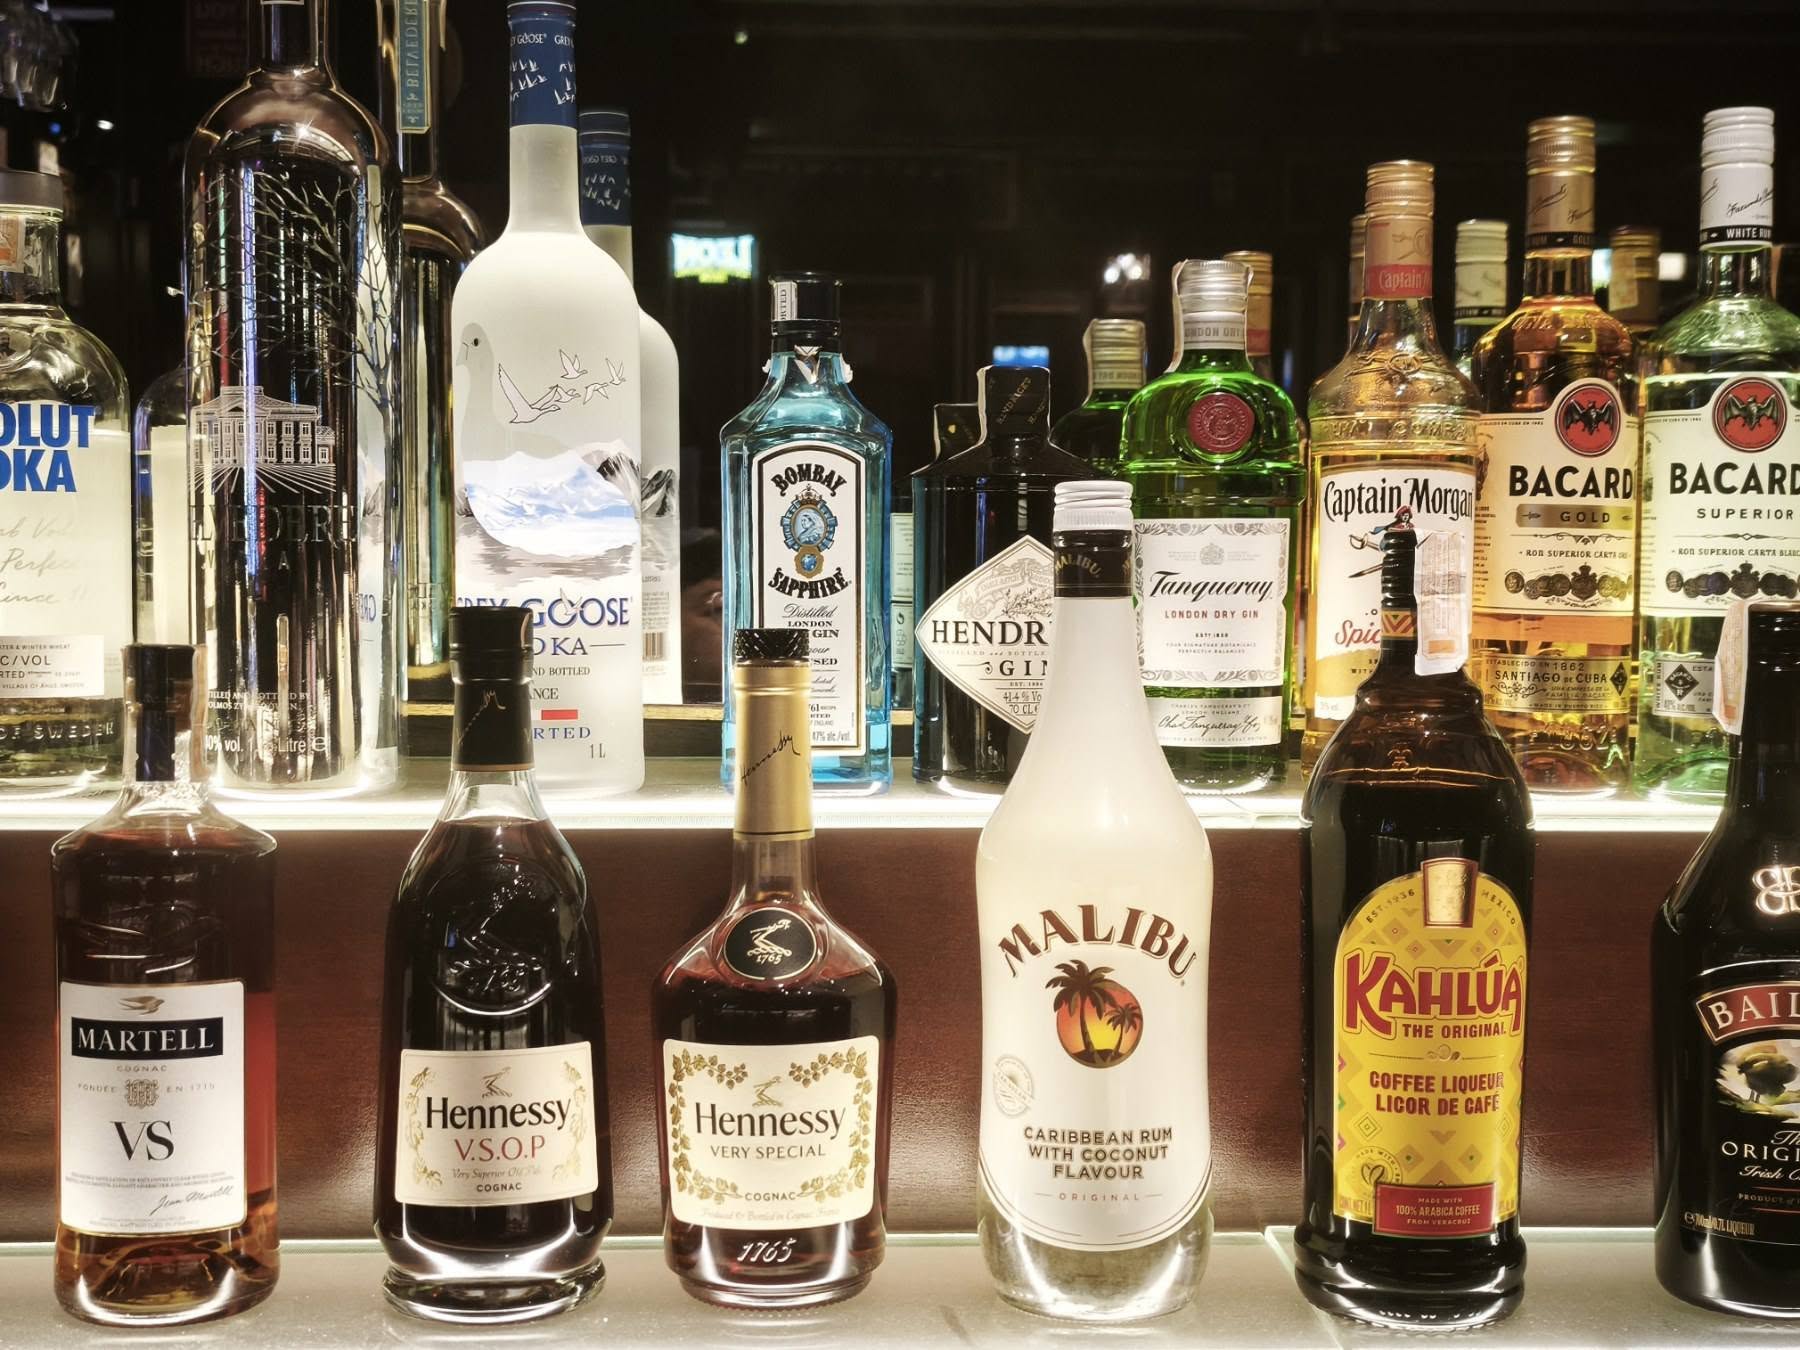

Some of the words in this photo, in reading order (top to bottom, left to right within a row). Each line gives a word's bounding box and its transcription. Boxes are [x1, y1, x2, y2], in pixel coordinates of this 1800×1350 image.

[1726, 228, 1757, 239] WHITE
[771, 463, 847, 497] BOMBAY
[1509, 465, 1633, 500] BACARD
[1324, 477, 1402, 523] Captain
[1560, 511, 1610, 523] GOLD
[1697, 508, 1794, 520] SUPERIOR
[1547, 550, 1592, 559] SUPERIOR
[1594, 551, 1617, 559] CARTA
[1698, 548, 1745, 556] SUPERIOR
[767, 566, 849, 599] SAPPHIRE
[1150, 570, 1273, 603] Tanqueray
[519, 597, 630, 627] GOOSE
[782, 603, 838, 618] Distilled
[1165, 610, 1208, 619] LONDON
[1214, 610, 1236, 619] DRY
[1242, 610, 1259, 619] GIN
[788, 620, 833, 628] LONDON
[812, 629, 840, 638] GIN
[932, 620, 1052, 646] HENDR
[549, 667, 591, 676] BOTTLED
[1553, 662, 1585, 671] 1862
[1495, 670, 1561, 683] SANTIAGO
[1576, 673, 1608, 684] CUBA
[1481, 889, 1516, 925] MEXICO
[998, 904, 1197, 978] MALIBU
[756, 954, 782, 965] 1765
[1345, 952, 1522, 1036] KAHLÚA
[1708, 992, 1800, 1030] BAIL
[1402, 1023, 1434, 1038] THE
[78, 1027, 214, 1052] MARTELL
[116, 1065, 168, 1073] COGNAC
[166, 1085, 183, 1093] EN
[1369, 1070, 1436, 1093] COFFEE
[1441, 1071, 1504, 1094] LIQUEUR
[1376, 1094, 1431, 1116] LICOR
[1437, 1097, 1459, 1116] DE
[1464, 1091, 1500, 1115] CAFÉ
[426, 1097, 571, 1131] Hennessy
[695, 1102, 846, 1140] Hennessy
[110, 1120, 175, 1162] VS
[1024, 1126, 1133, 1146] CARIBBEAN
[1140, 1127, 1172, 1143] RUM
[454, 1135, 546, 1162] V.S.O.P
[710, 1145, 751, 1159] VERY
[755, 1144, 826, 1159] SPECIAL
[1029, 1145, 1073, 1160] WITH
[1082, 1146, 1169, 1162] COCONUT
[1053, 1165, 1144, 1180] FLAVOUR
[1739, 1165, 1784, 1179] Irish
[476, 1183, 523, 1193] COGNAC
[745, 1192, 797, 1201] COGNAC
[1059, 1193, 1140, 1201] ORIGINAL
[1396, 1205, 1417, 1215] 100%
[1419, 1206, 1454, 1216] ARABICA
[1455, 1204, 1480, 1215] COFFEE
[737, 1237, 797, 1263] 1765
